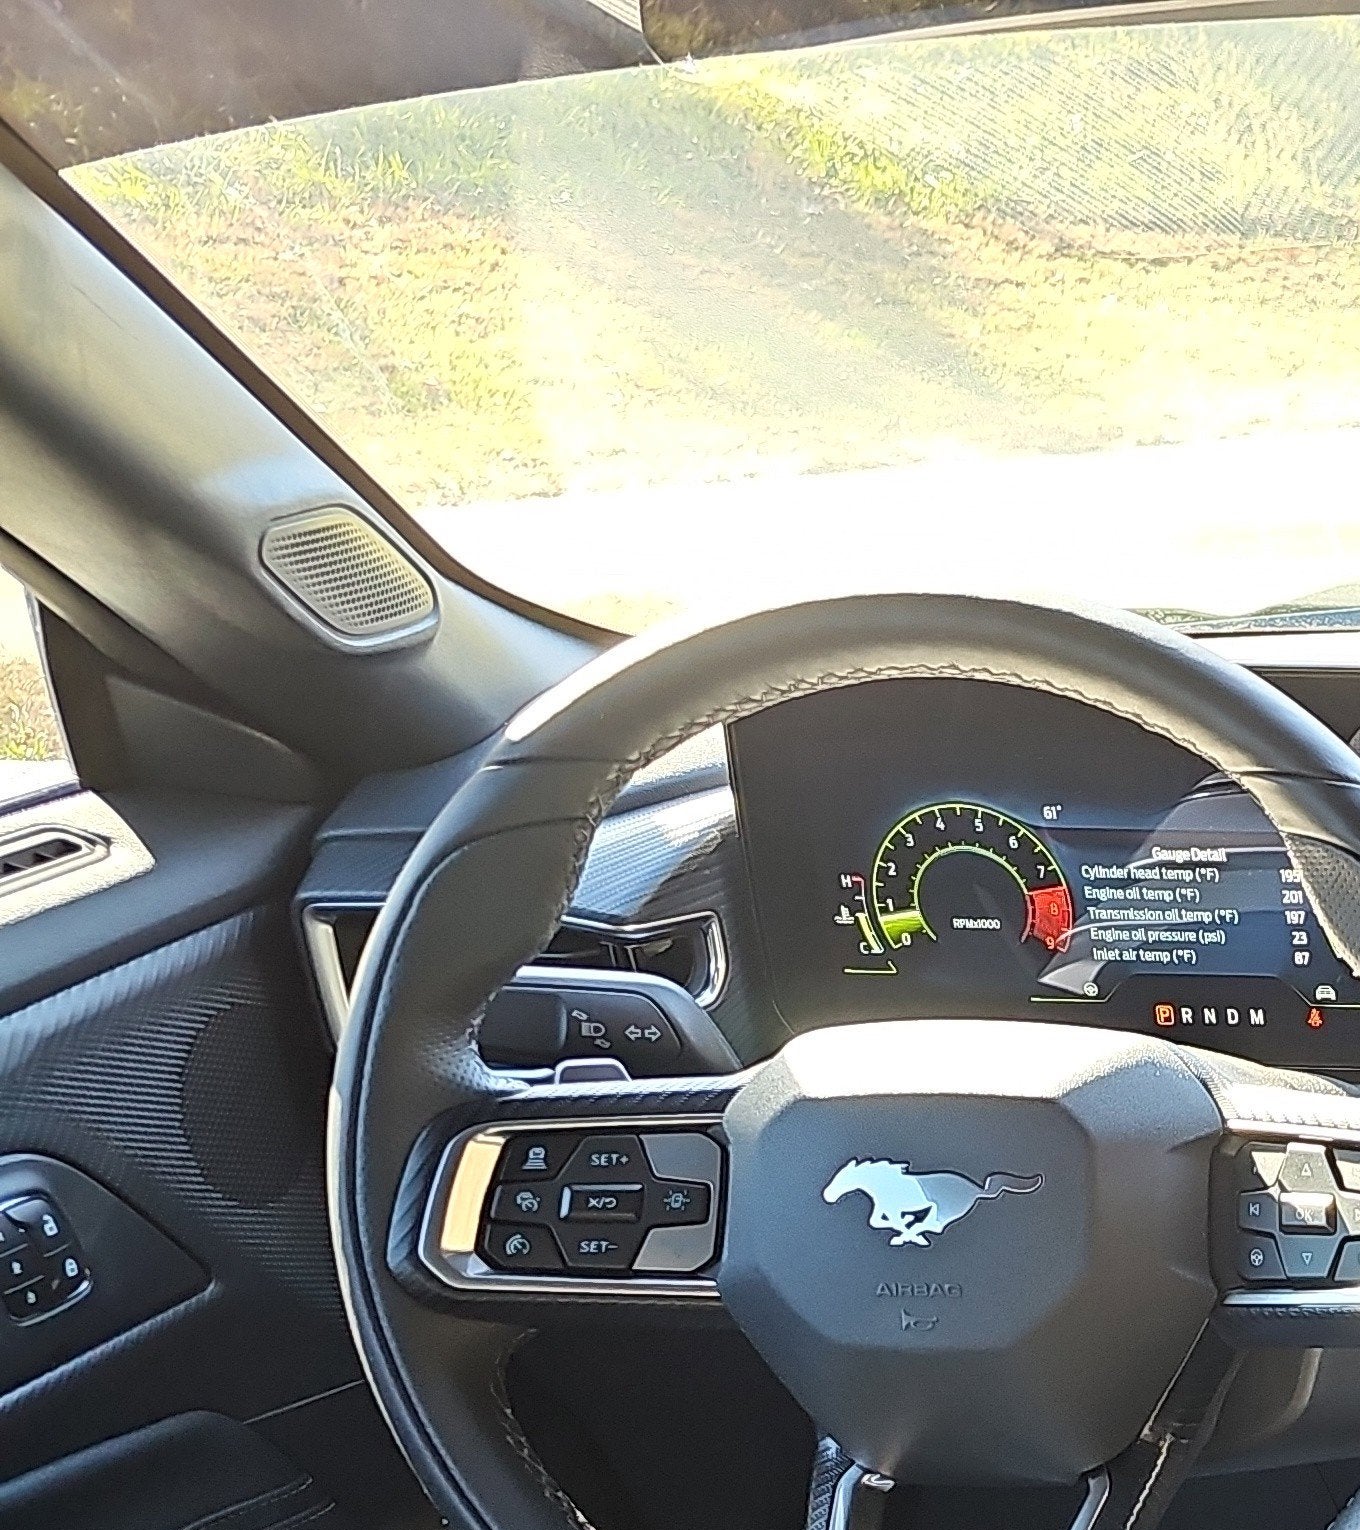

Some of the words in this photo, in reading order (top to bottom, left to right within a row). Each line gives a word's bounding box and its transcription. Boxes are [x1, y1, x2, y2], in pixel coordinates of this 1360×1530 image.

[935, 817, 946, 831] 4
[974, 818, 984, 832] 5
[906, 834, 916, 847] 3
[1008, 836, 1019, 849] 6
[1152, 848, 1190, 863] Gauge
[1191, 848, 1228, 862] Detail
[887, 863, 897, 876] 2
[1036, 865, 1046, 879] 7
[1081, 865, 1129, 880] Cylinder
[1130, 867, 1160, 880] head
[1162, 869, 1194, 882] temp
[840, 874, 852, 888] H
[1084, 886, 1124, 901] Engine
[1125, 887, 1142, 900] oil
[1142, 889, 1174, 902] temp
[1282, 890, 1304, 904] 201
[1087, 907, 1164, 921] Transmission
[1164, 908, 1180, 921] oil
[1180, 910, 1213, 924] temp
[1285, 910, 1306, 925] 197
[1090, 929, 1130, 943] Engine
[1131, 929, 1147, 942] oil
[1148, 930, 1197, 944] pressure
[1198, 930, 1226, 945] (psi)
[1291, 931, 1308, 945] 23
[1093, 948, 1122, 961] Inlet
[1122, 948, 1139, 961] air
[1139, 949, 1171, 964] temp
[1294, 951, 1311, 966] 87
[1160, 1007, 1172, 1022] P
[1180, 1008, 1193, 1024] R
[1203, 1009, 1217, 1025] N
[1226, 1009, 1240, 1025] D
[1249, 1009, 1265, 1026] M
[1296, 1209, 1315, 1222] OK
[876, 1282, 963, 1298] AIRBAG
